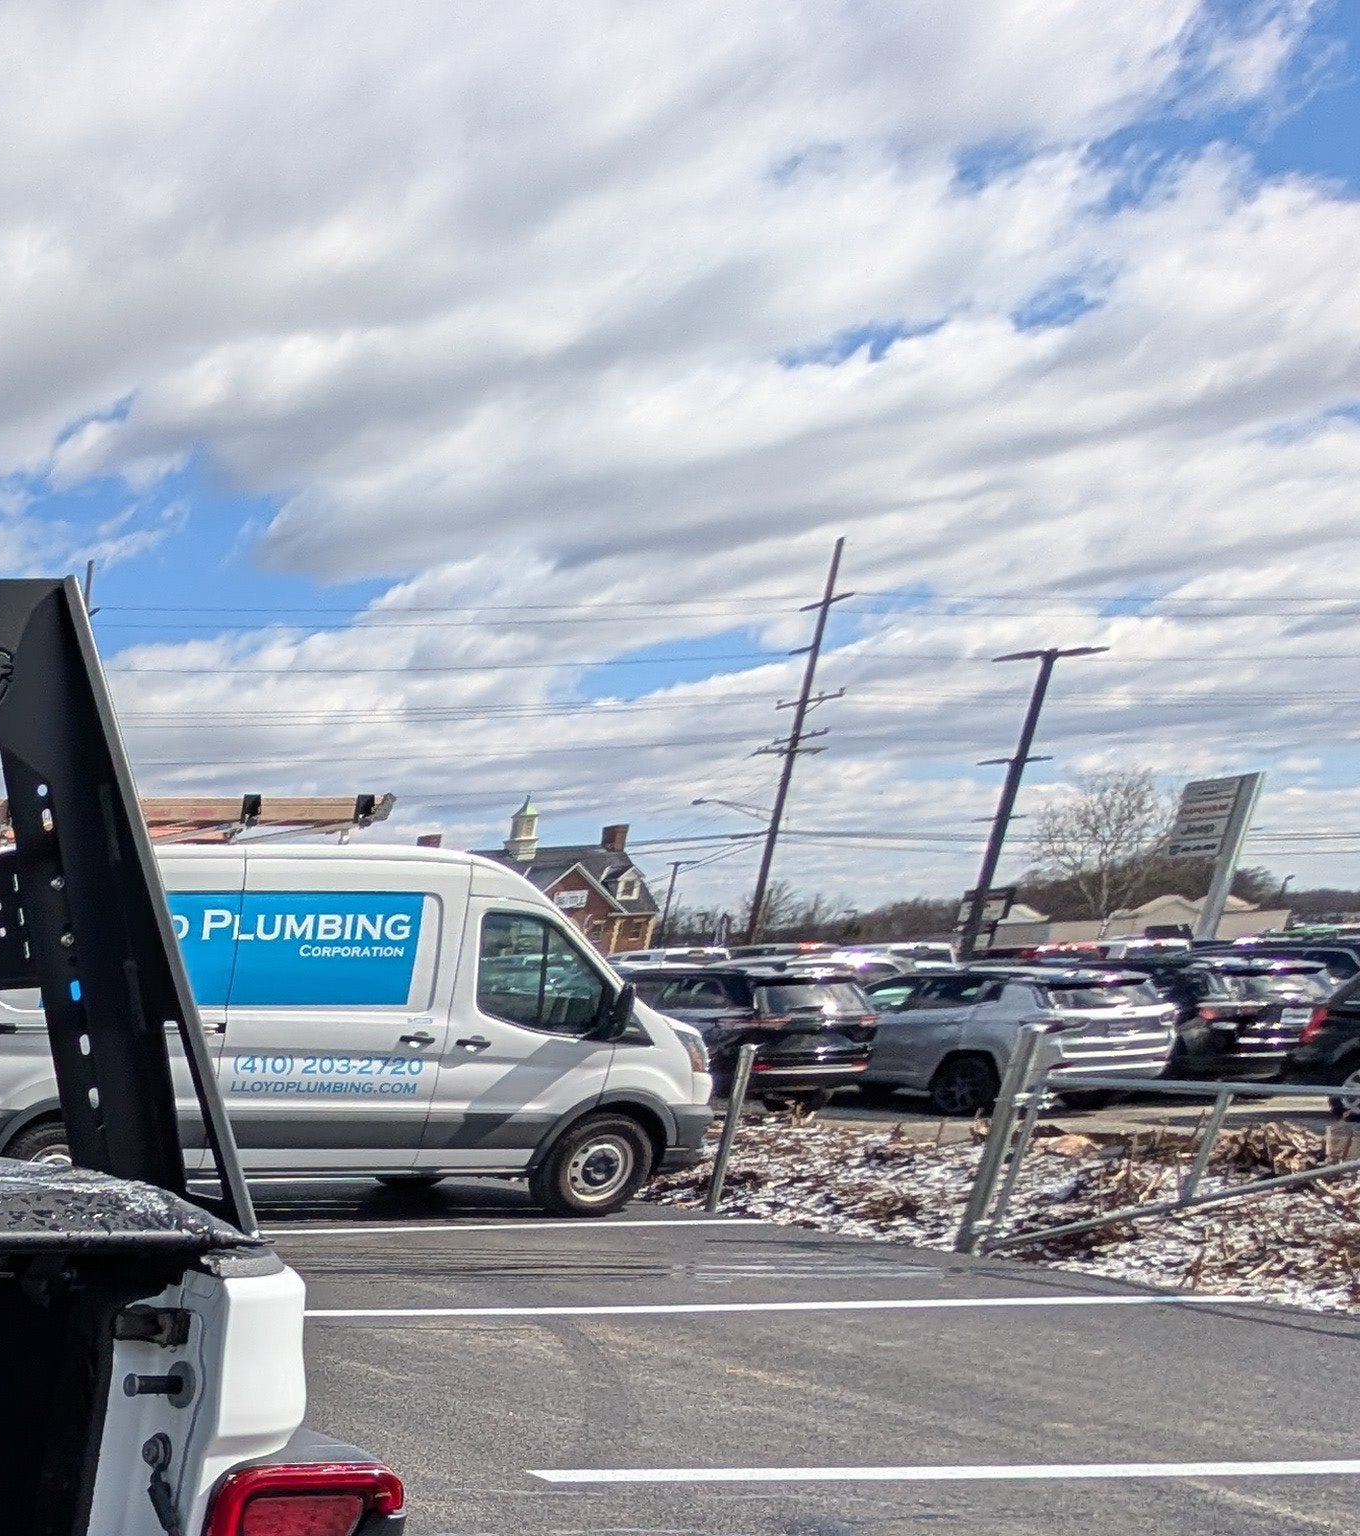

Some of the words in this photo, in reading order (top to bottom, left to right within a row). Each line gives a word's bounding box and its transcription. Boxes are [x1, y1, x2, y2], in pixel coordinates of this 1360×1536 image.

[233, 1054, 295, 1076] (410)
[301, 1055, 425, 1076] 203-2720
[230, 1080, 417, 1094] LLOYDPLUMBING.COM
